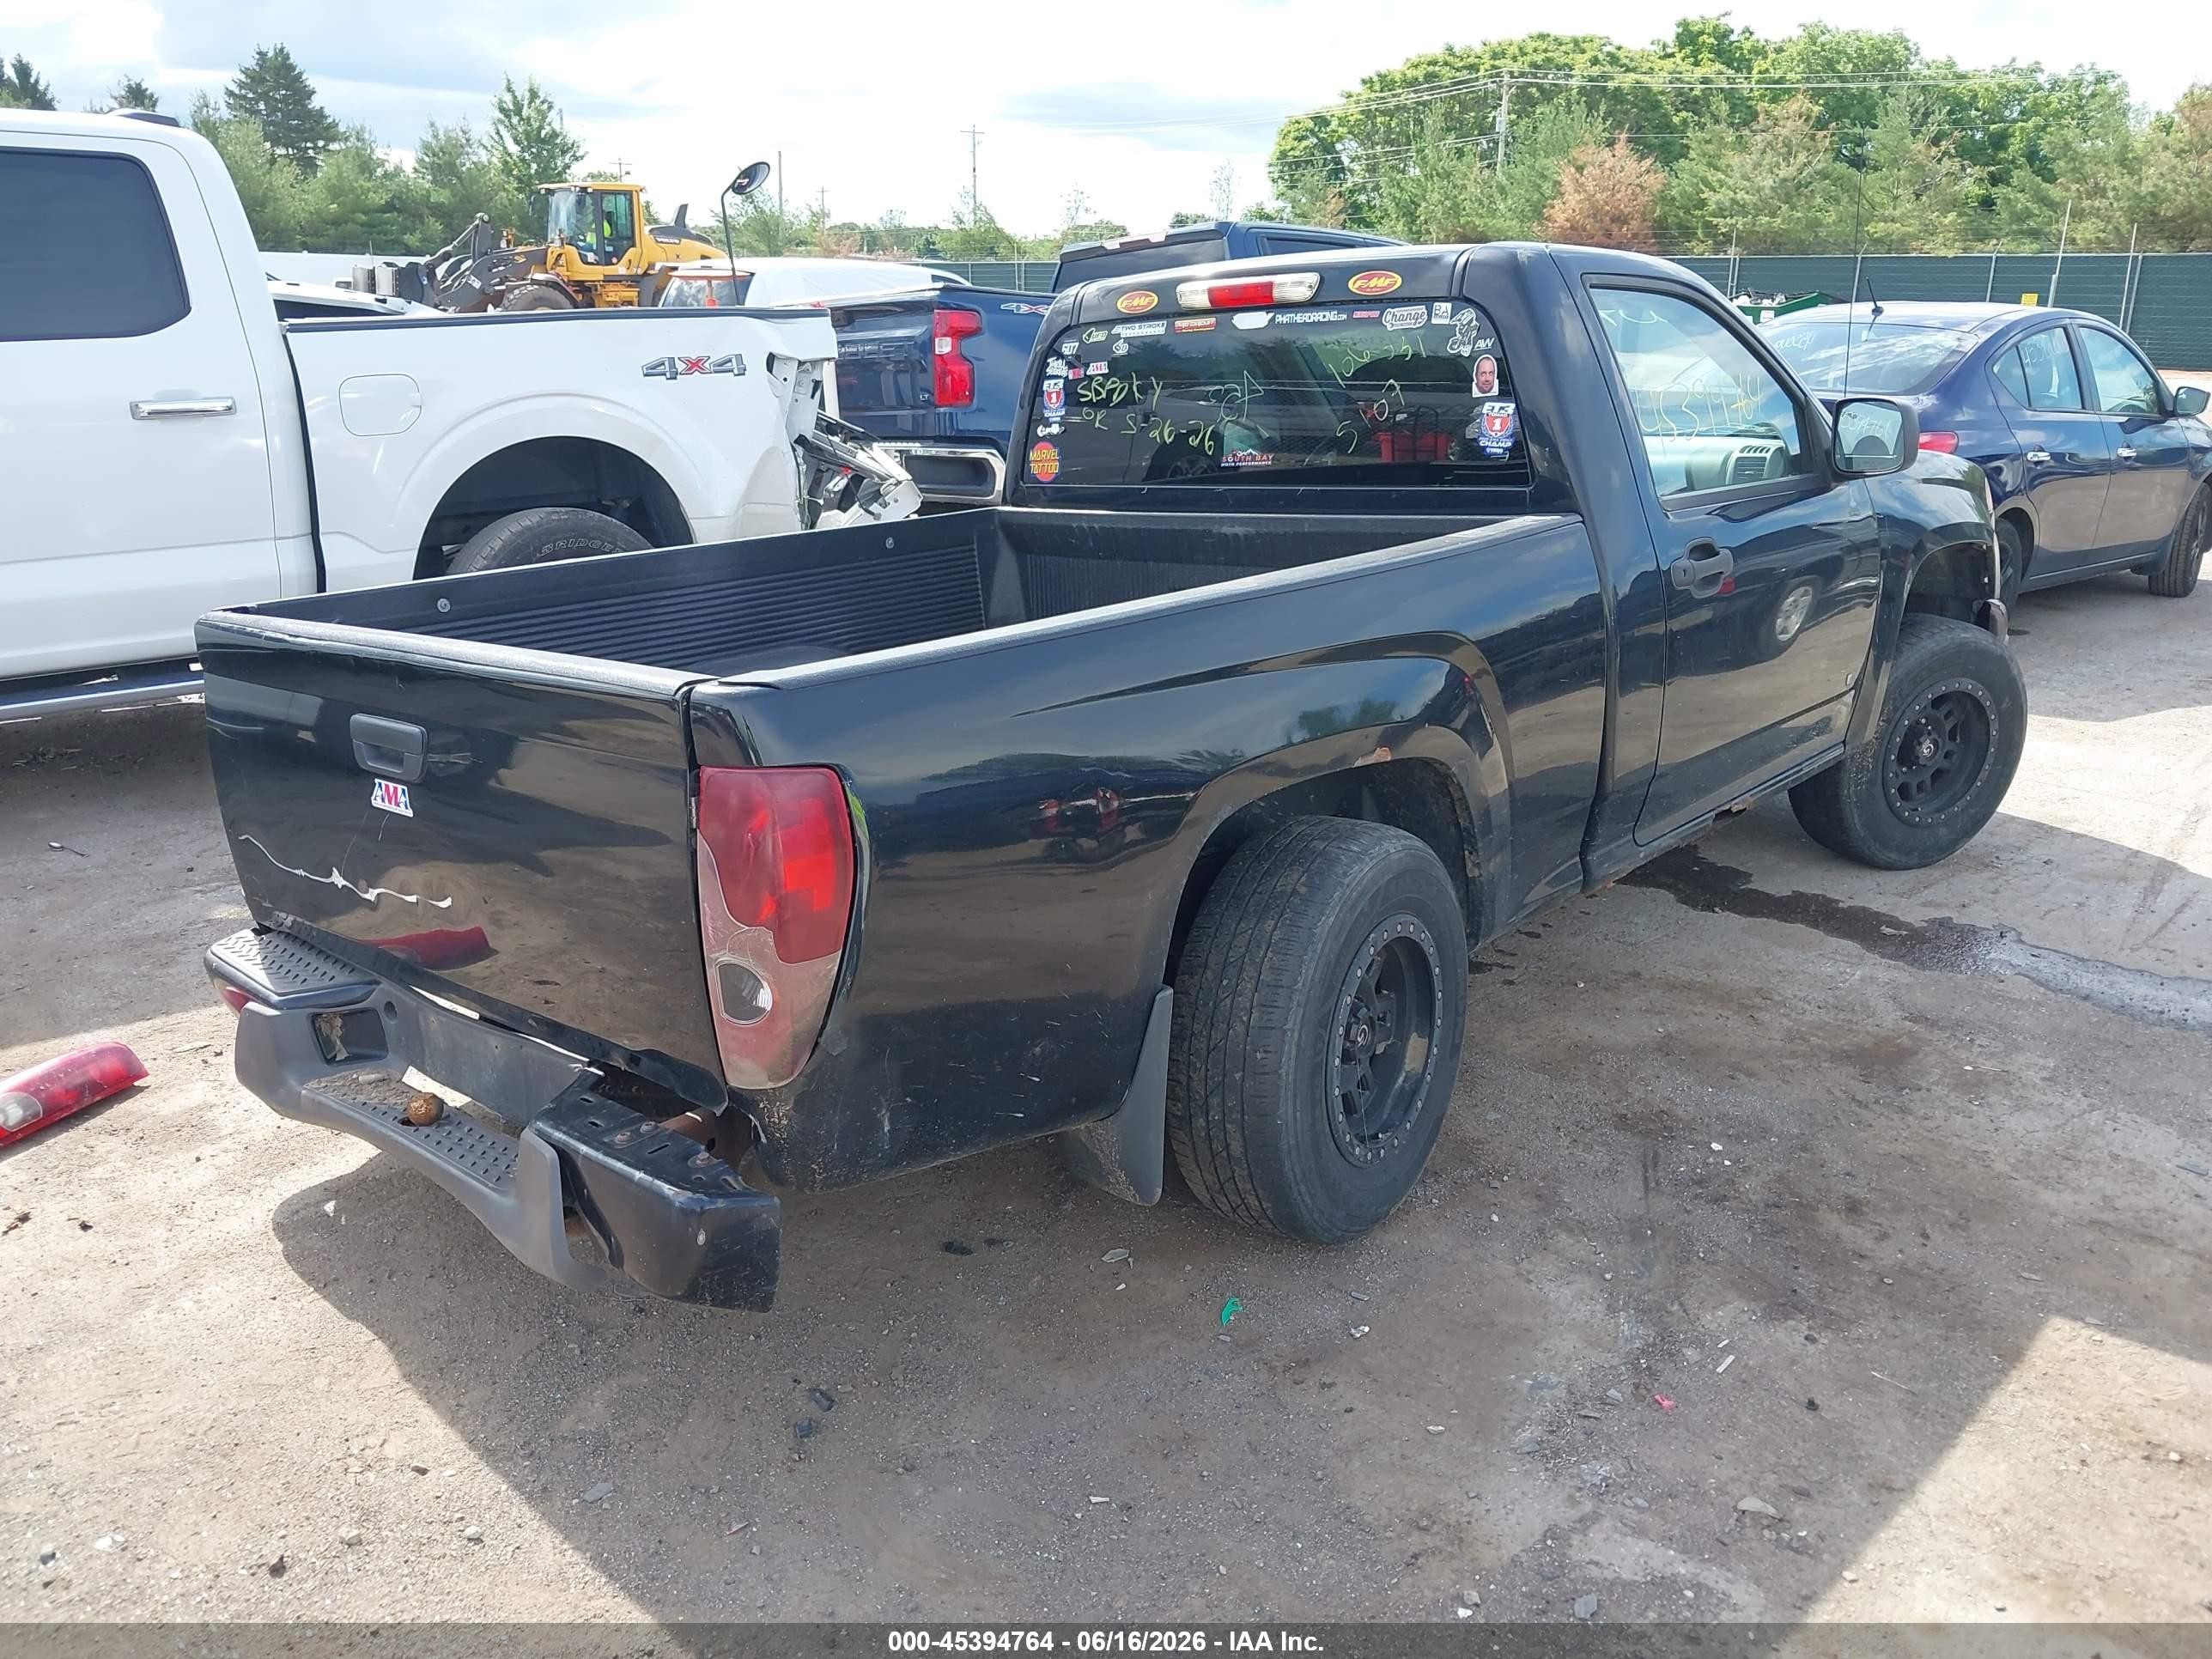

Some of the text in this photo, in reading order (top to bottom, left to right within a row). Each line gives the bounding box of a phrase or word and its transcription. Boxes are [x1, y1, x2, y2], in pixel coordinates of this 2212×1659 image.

[1353, 276, 1396, 289] FMF
[1121, 295, 1155, 307] FMF
[1383, 310, 1426, 325] Change
[1473, 337, 1494, 349] AW
[641, 354, 746, 380] 4X4
[1483, 404, 1515, 413] ET3
[1492, 418, 1502, 430] 1
[1030, 449, 1060, 461] MARVEL
[1030, 463, 1060, 474] TATTOO
[373, 781, 410, 810] AMA
